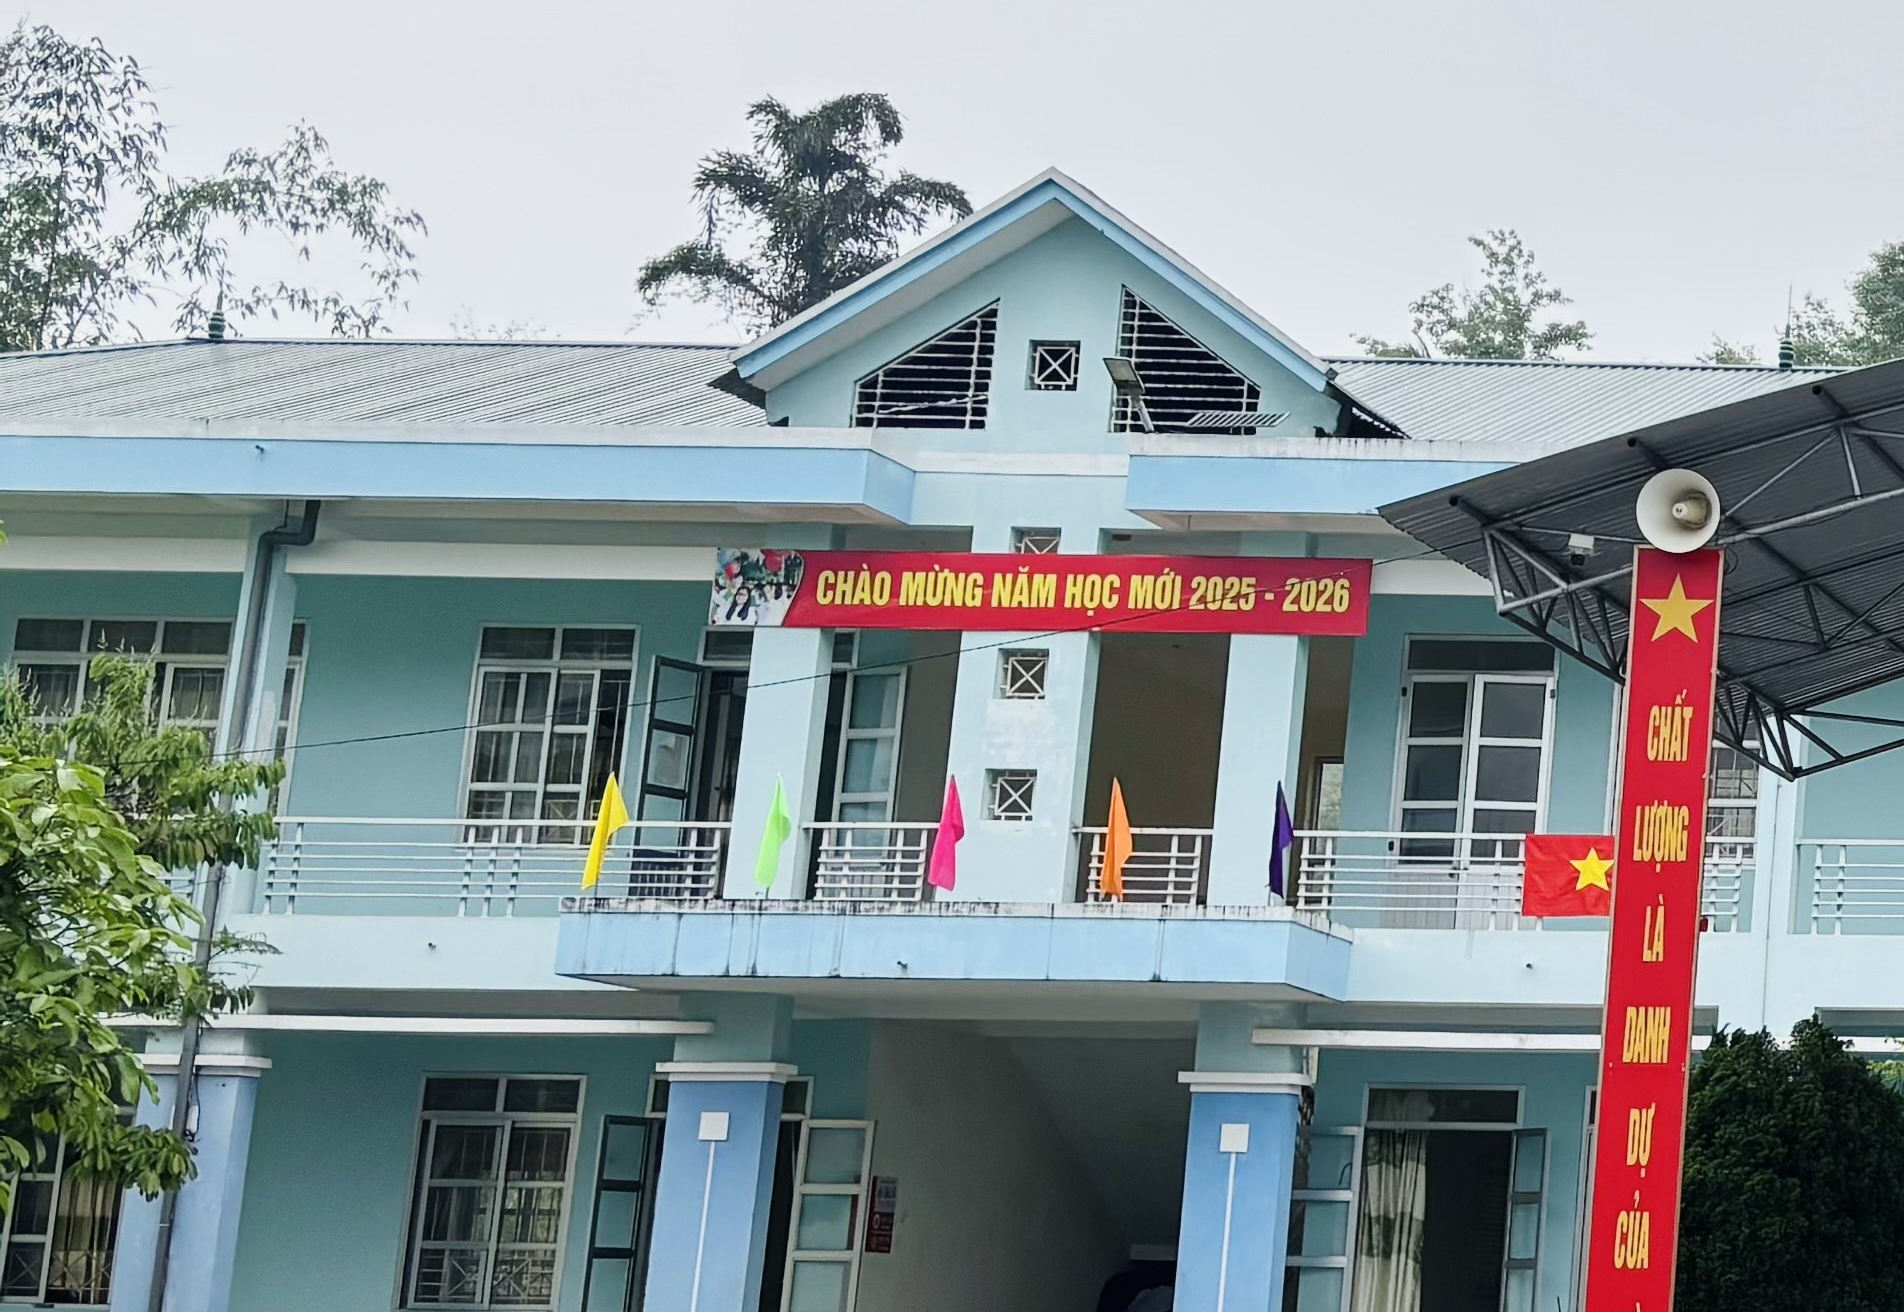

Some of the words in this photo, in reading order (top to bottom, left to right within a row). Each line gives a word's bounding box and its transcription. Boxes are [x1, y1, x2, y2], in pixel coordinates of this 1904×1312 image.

[815, 565, 891, 608] CHÀO
[899, 562, 983, 609] MỪNG
[992, 566, 1057, 609] NĂM
[1064, 571, 1119, 617] HỌC
[1128, 566, 1182, 611] MỚI
[1190, 575, 1256, 611] 2025
[1283, 577, 1351, 614] 2026
[1646, 689, 1695, 763] CHẤT
[1631, 799, 1690, 873] LƯỢNG
[1642, 893, 1665, 963] LÀ
[1621, 1005, 1673, 1064] DANH
[1626, 1102, 1657, 1178] DỰ
[1613, 1190, 1650, 1270] CỦA
